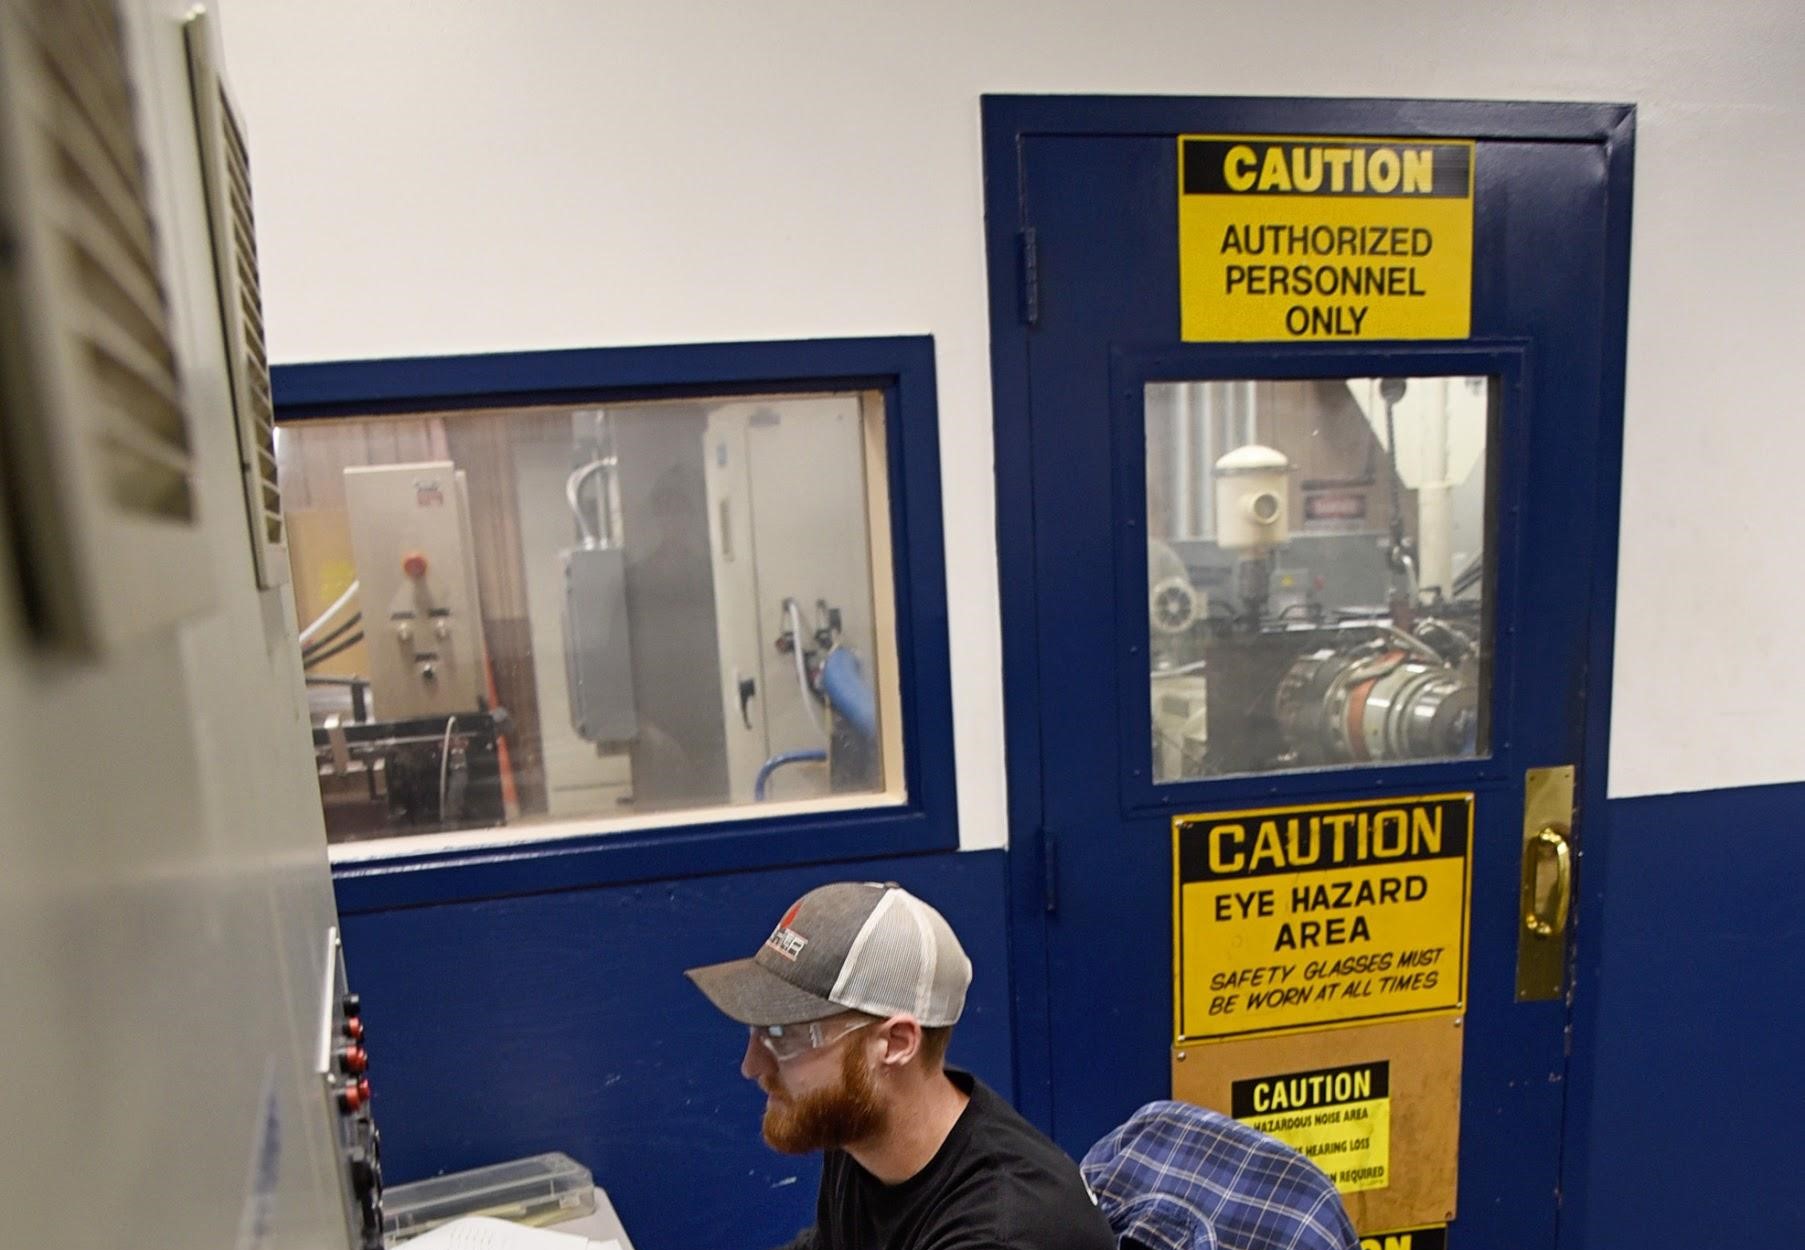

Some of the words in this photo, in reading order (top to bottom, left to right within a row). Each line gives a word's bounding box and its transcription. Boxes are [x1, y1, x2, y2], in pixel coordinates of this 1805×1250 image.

[1222, 145, 1433, 193] CAUTION
[1220, 225, 1433, 257] AUTHORIZED
[1226, 265, 1426, 296] PERSONNEL
[1285, 305, 1369, 336] ONLY
[1208, 806, 1443, 874] CAUTION
[1214, 889, 1274, 922] EYE
[1291, 875, 1428, 914] HAZARD
[1274, 916, 1371, 952] AREA
[1210, 965, 1295, 991] SAFETY
[1304, 952, 1393, 981] GLASSES
[1397, 948, 1444, 969] MUST
[1208, 994, 1239, 1016] BE
[1246, 984, 1314, 1010] WORN
[1313, 983, 1341, 1001] AT
[1341, 979, 1373, 999] ALL
[1379, 970, 1439, 993] TIMES
[1253, 1069, 1371, 1112] CAUTION
[1253, 1115, 1312, 1132] HAZARDOUS
[1314, 1111, 1341, 1126] NOISE
[1343, 1108, 1369, 1122] AREA
[1305, 1141, 1347, 1156] HEARING
[1350, 1138, 1370, 1150] LOSS
[1339, 1166, 1385, 1184] REQUIRED
